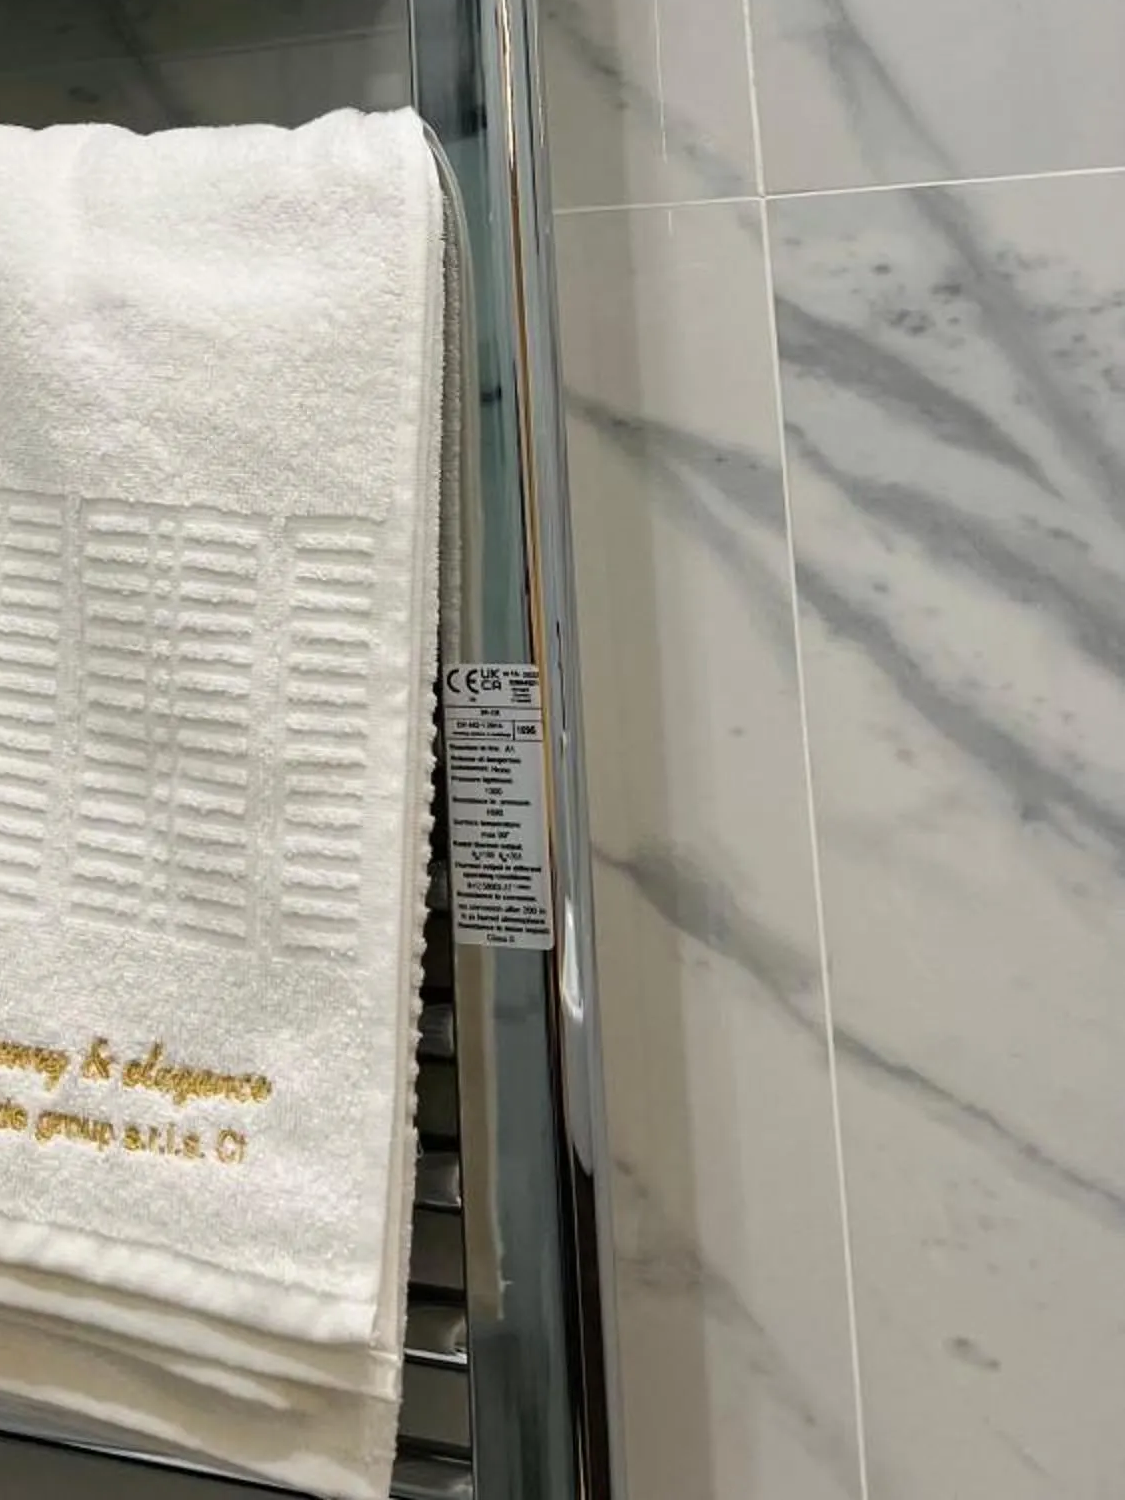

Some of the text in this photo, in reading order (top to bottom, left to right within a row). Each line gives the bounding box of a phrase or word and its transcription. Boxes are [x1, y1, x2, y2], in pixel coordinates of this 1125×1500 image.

[82, 1037, 114, 1080] &
[122, 1039, 274, 1106] elegance
[35, 1109, 116, 1152] group
